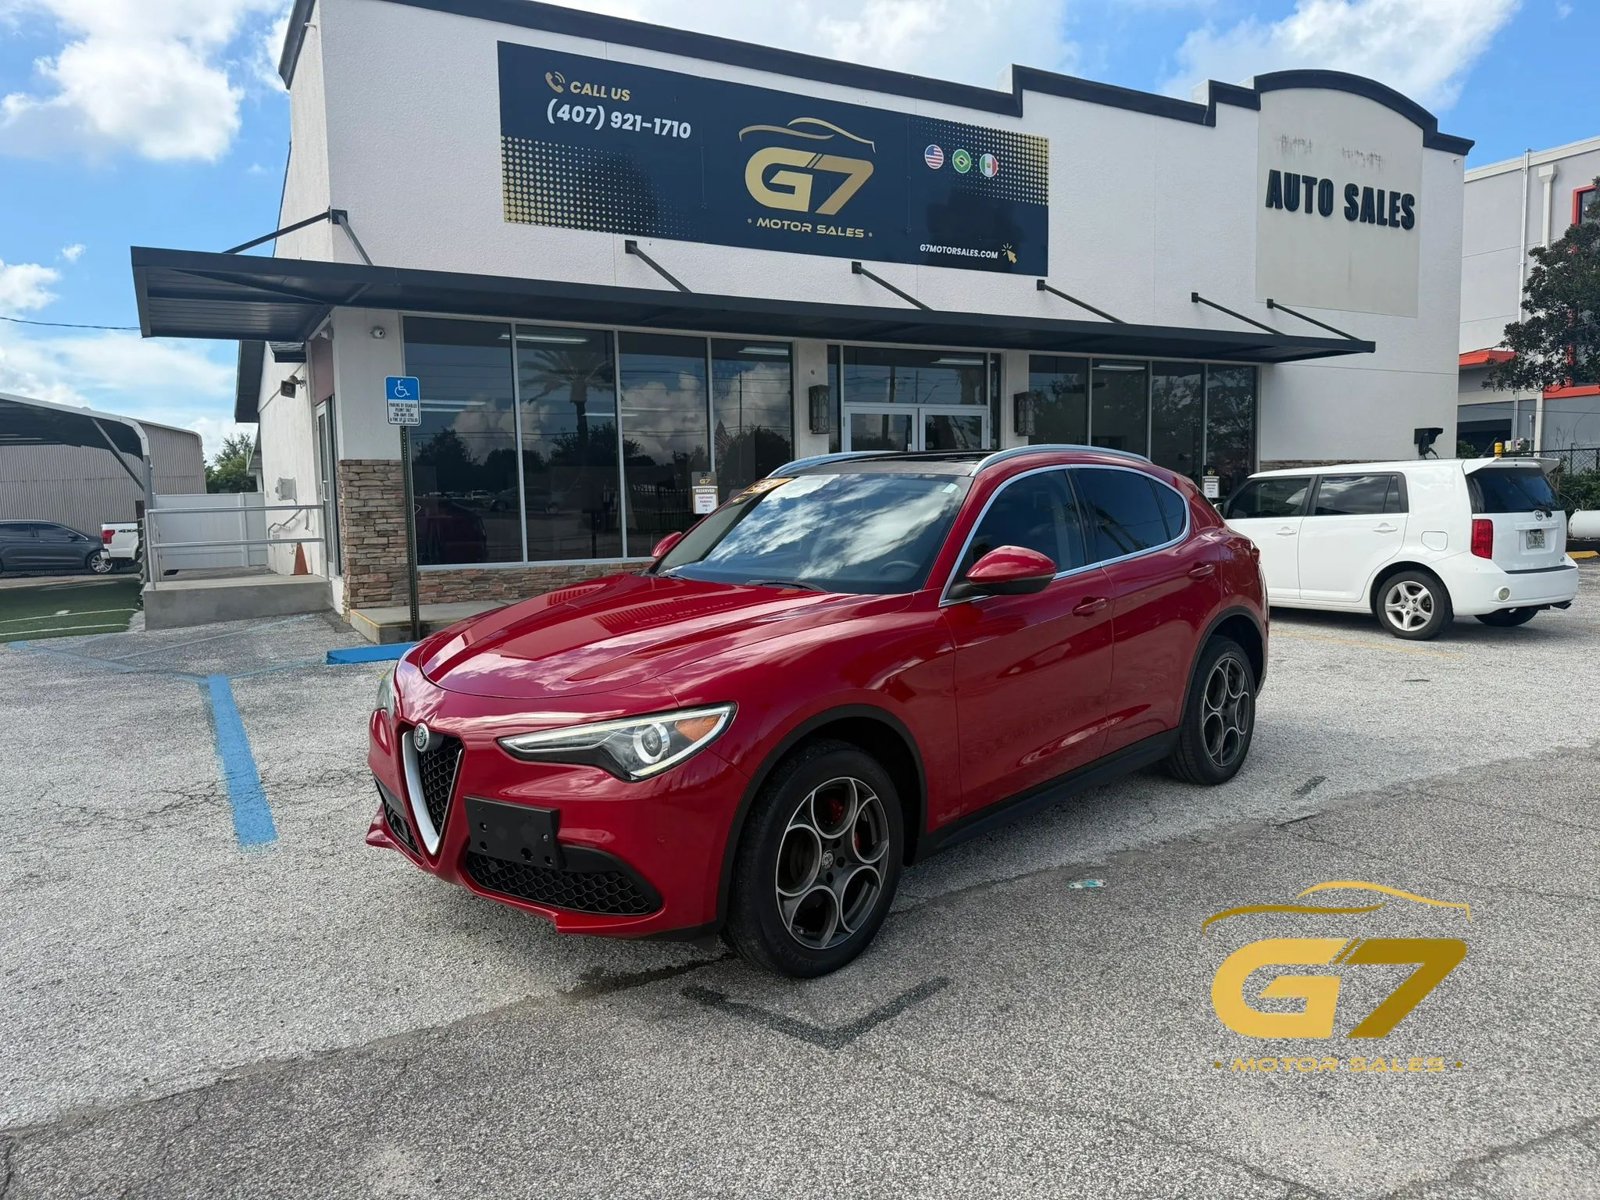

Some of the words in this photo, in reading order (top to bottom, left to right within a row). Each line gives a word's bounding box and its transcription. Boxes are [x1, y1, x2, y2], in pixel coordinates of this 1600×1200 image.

[570, 81, 607, 98] CALL
[611, 88, 631, 101] US
[547, 98, 605, 130] (407)
[610, 111, 691, 139] 921-1710
[745, 146, 874, 215] G7
[1265, 169, 1334, 217] AUTO
[1344, 183, 1415, 230] SALES
[757, 217, 812, 233] MOTOR
[816, 224, 865, 238] SALES
[920, 243, 998, 259] G7MOTORSALES.COM
